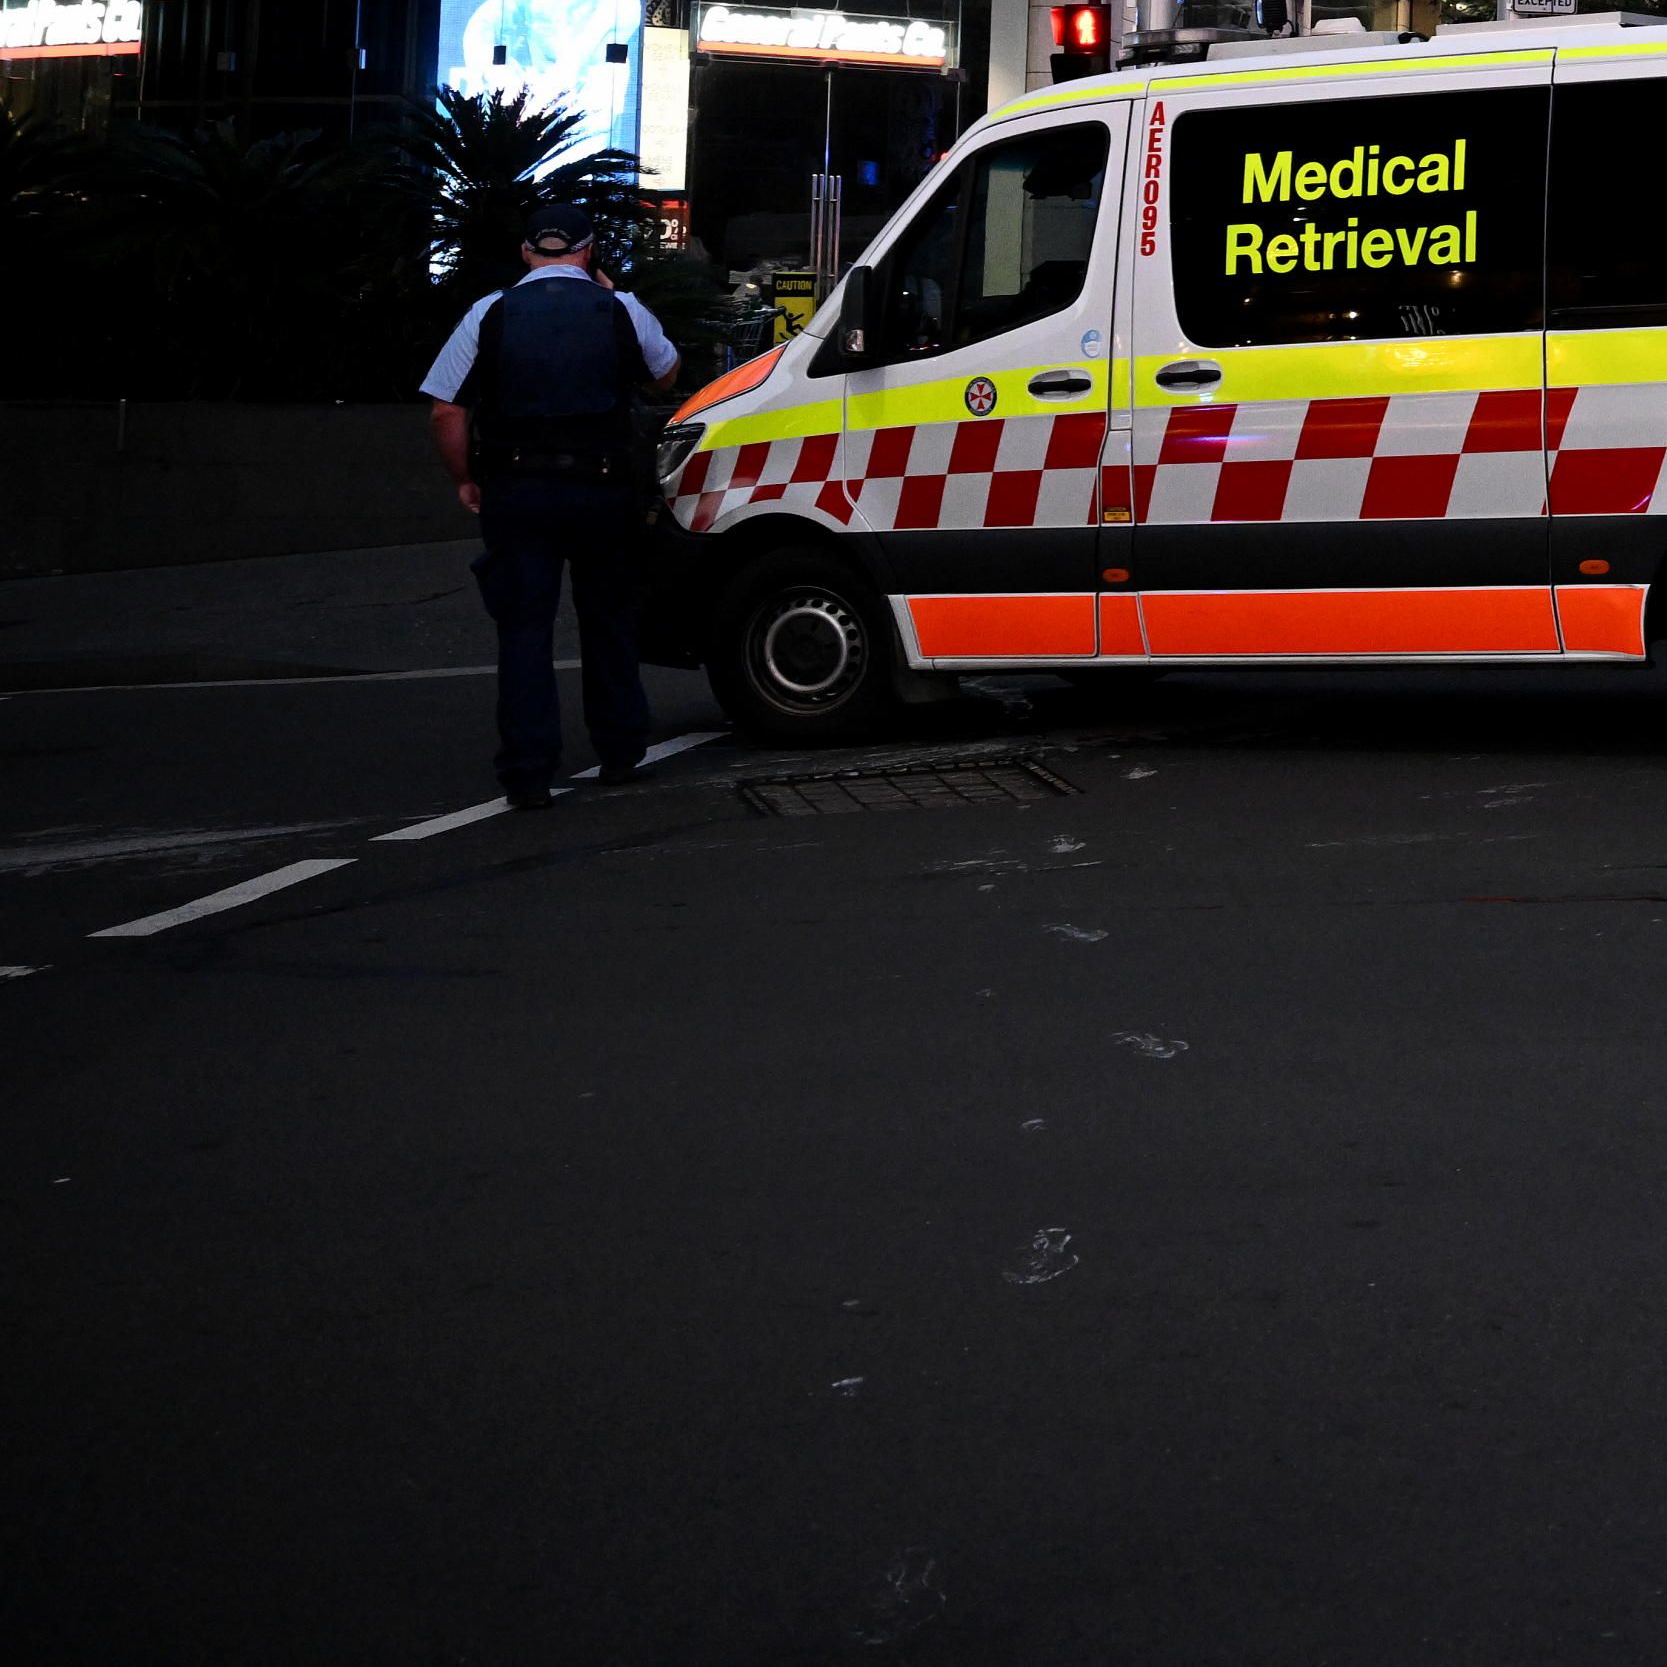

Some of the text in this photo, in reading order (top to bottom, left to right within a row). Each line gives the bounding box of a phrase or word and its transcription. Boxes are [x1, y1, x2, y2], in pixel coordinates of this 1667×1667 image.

[1242, 138, 1467, 204] Medical
[1225, 210, 1477, 275] Retrieval
[776, 280, 812, 291] CAUTION
